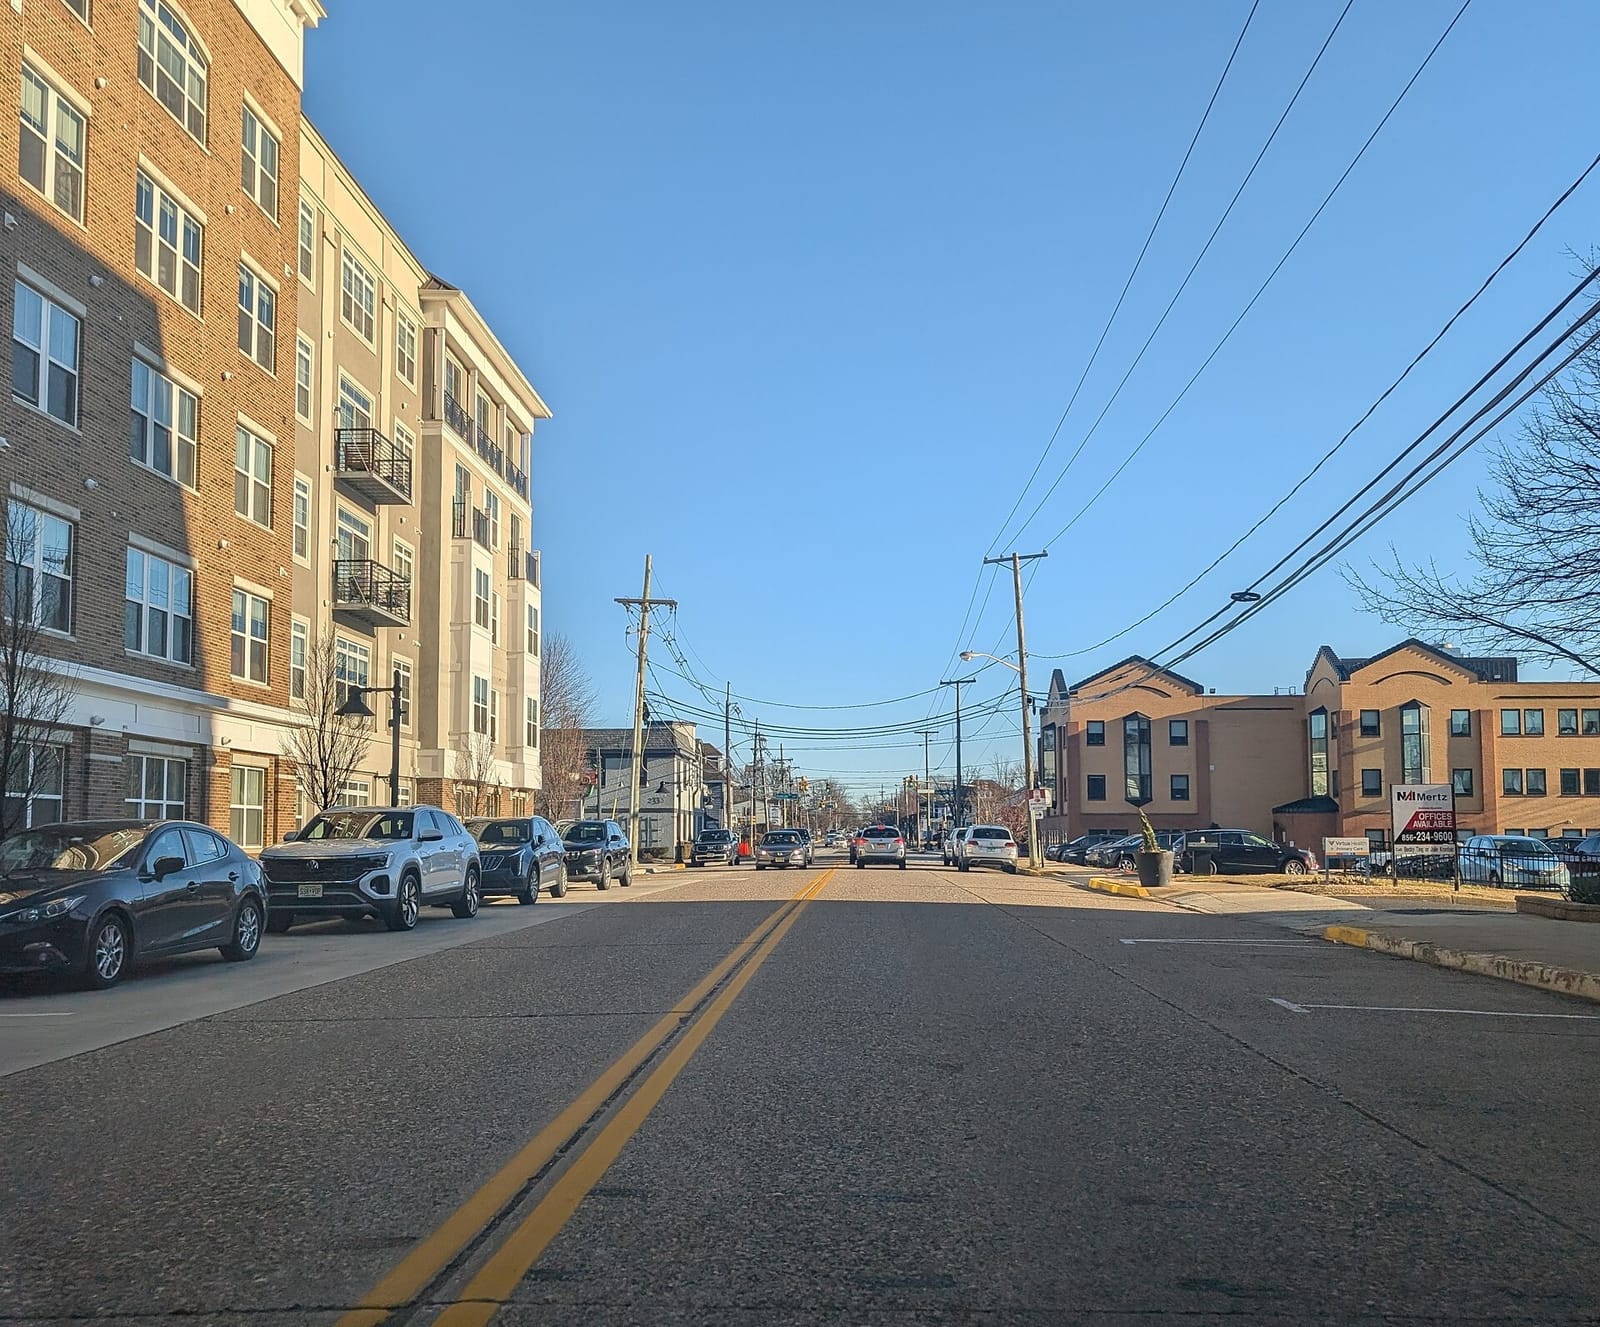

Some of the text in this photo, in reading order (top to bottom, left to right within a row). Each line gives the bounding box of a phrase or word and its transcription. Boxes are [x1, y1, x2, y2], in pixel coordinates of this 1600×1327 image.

[1397, 790, 1448, 801] NAI Mertz
[1418, 812, 1452, 820] OFFICES
[1413, 820, 1453, 828] AVAILABLE
